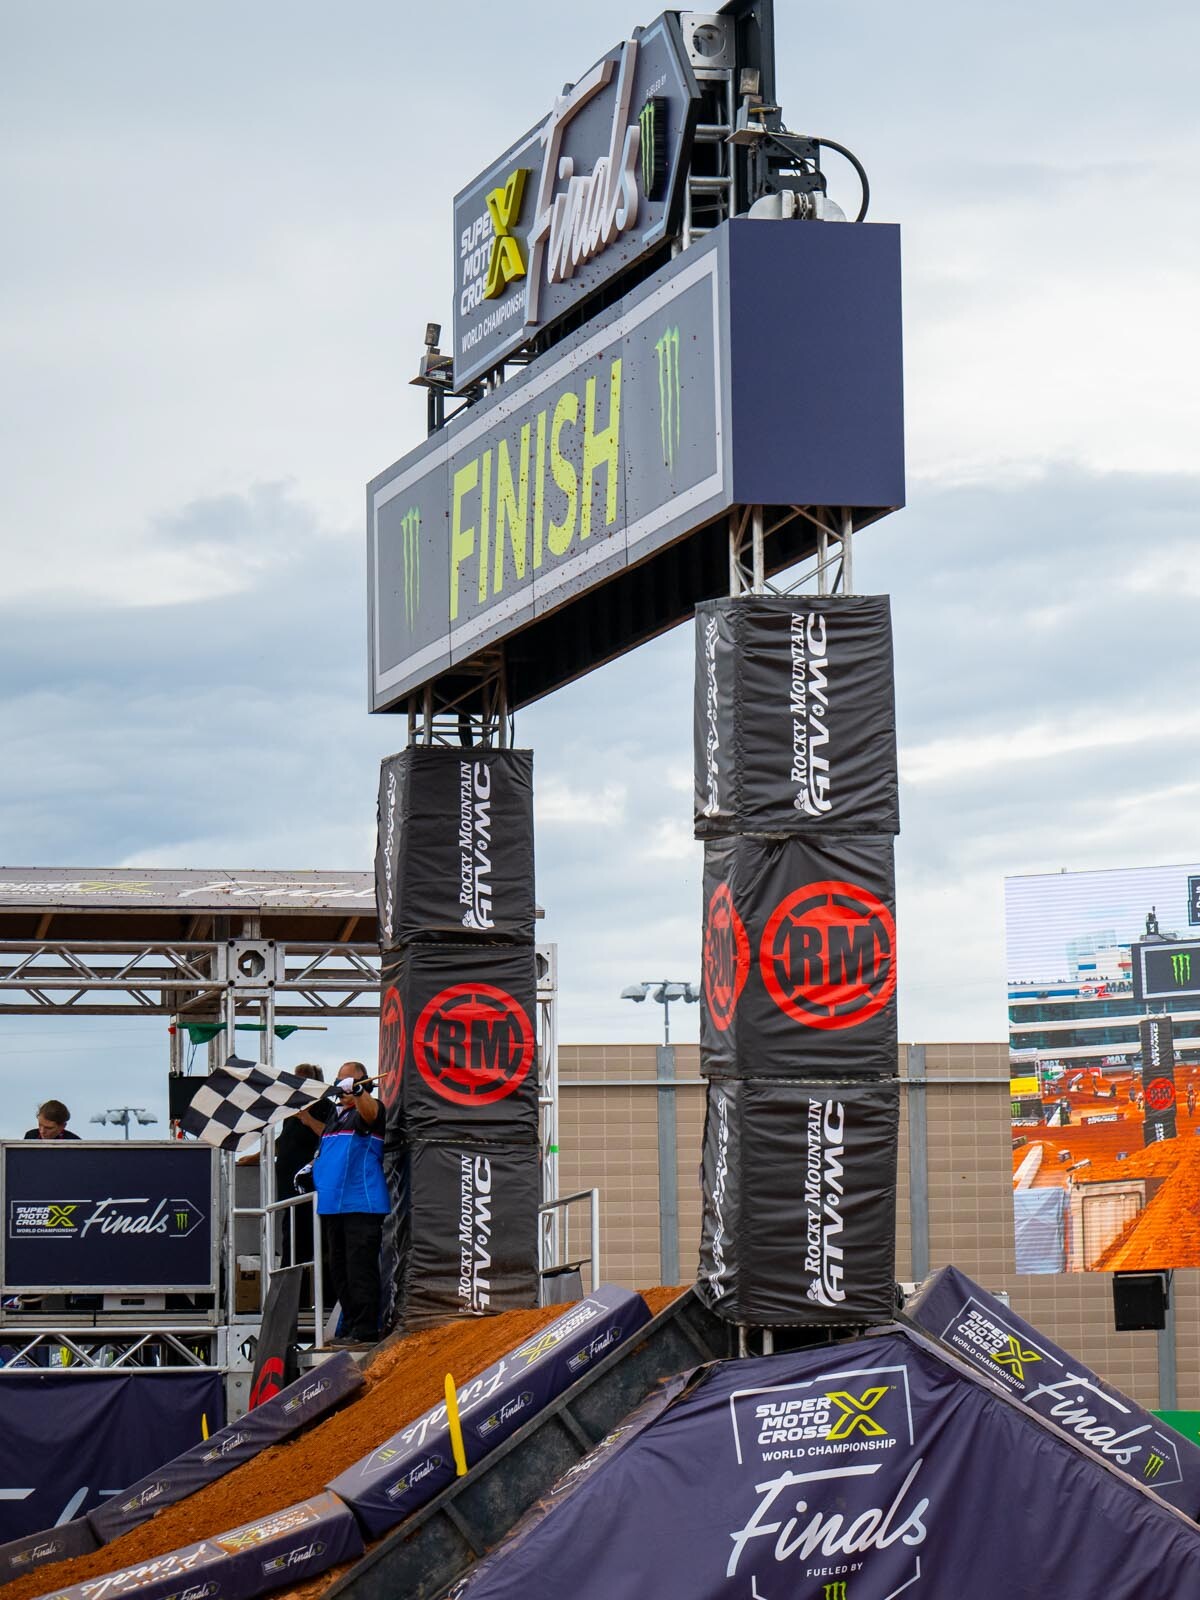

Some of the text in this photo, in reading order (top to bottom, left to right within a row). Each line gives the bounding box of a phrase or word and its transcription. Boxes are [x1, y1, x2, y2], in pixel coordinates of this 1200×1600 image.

[525, 39, 640, 326] Finals
[484, 168, 532, 300] X
[462, 288, 528, 353] WORLD CHAMPIONSHI
[449, 358, 622, 622] FINISH
[790, 613, 807, 783] ROCKY MOUNTAIN
[459, 761, 474, 905] ROCKY MOUNTAIN
[789, 925, 876, 987] RM
[438, 1019, 510, 1069] RM
[804, 1098, 824, 1275] ROCKY MOUNTAIN
[80, 1197, 169, 1238] Finals
[458, 1155, 473, 1300] ROCKY MOUNTAIN
[589, 1330, 614, 1359] Finals
[957, 1324, 999, 1355] CROSS
[964, 1319, 1005, 1349] MOTO
[967, 1310, 1010, 1345] SUPER
[952, 1334, 1027, 1391] WORLD CHAMPIONSHIP
[302, 1380, 325, 1404] Finals
[498, 1394, 526, 1424] Finals
[754, 1397, 832, 1418] SUPER
[761, 1411, 829, 1431] MOTO
[824, 1386, 889, 1441] X
[1022, 1371, 1153, 1465] Finals
[221, 1433, 245, 1456] Finals
[757, 1424, 833, 1445] CROSS
[762, 1438, 897, 1462] WORLD CHAMPIONSHIP
[409, 1458, 435, 1488] Finals
[140, 1484, 164, 1505] Finals
[726, 1458, 930, 1578] Finals
[287, 1545, 316, 1568] Finals
[806, 1562, 863, 1577] FUELED BY
